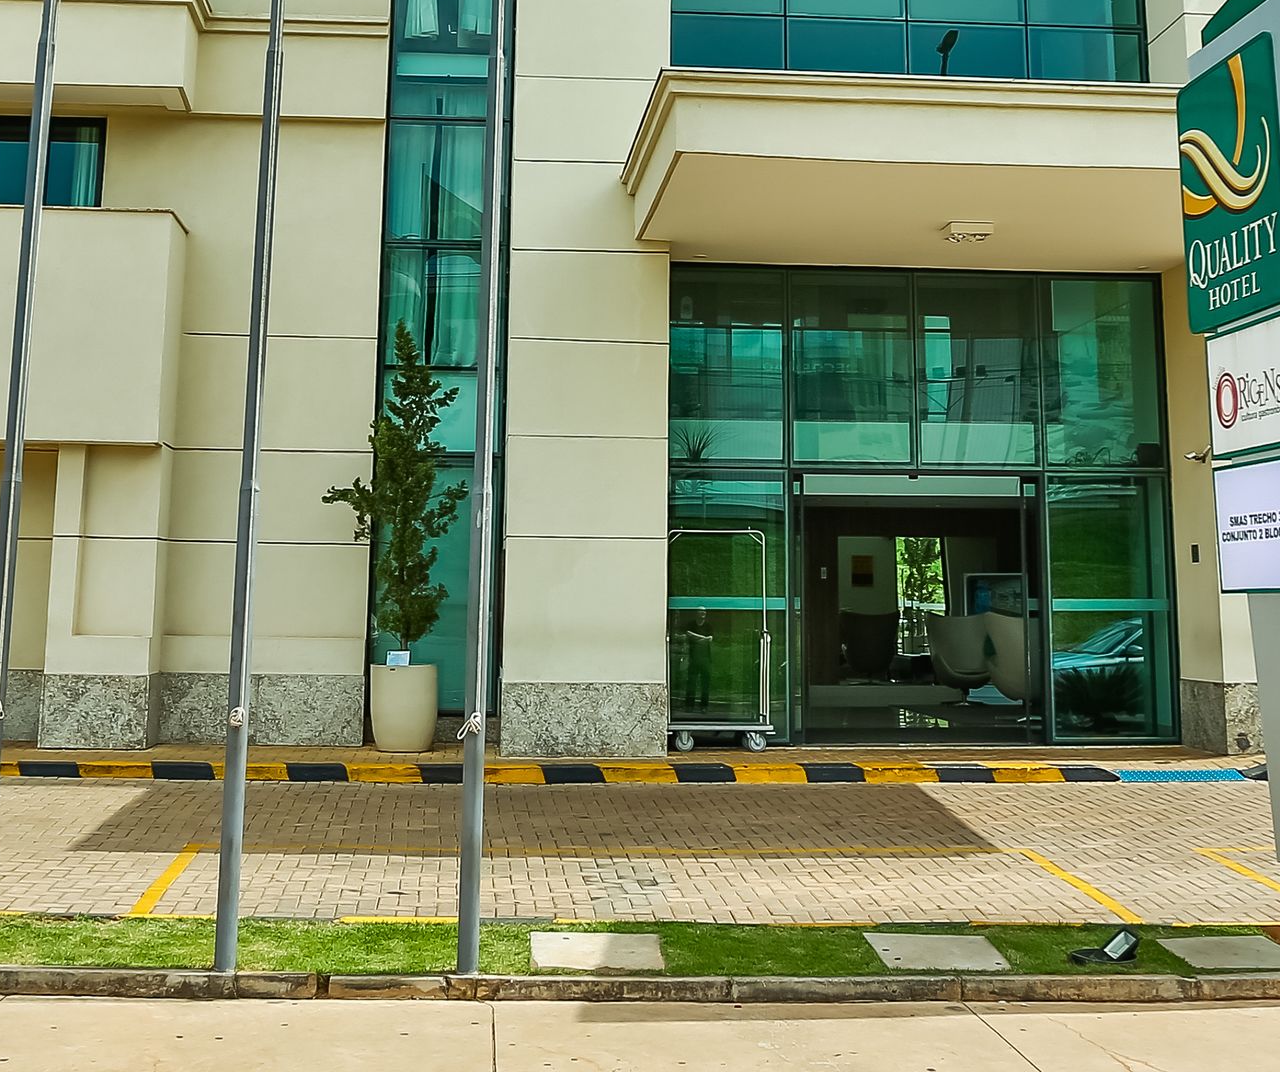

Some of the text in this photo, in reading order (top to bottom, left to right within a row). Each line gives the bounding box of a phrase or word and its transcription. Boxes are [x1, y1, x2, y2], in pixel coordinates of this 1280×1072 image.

[1189, 212, 1277, 289] QUALITY
[1208, 272, 1260, 310] HOTEL
[1249, 512, 1277, 525] TRECHO
[1222, 529, 1257, 542] CONJUNTO
[1258, 529, 1263, 539] 2
